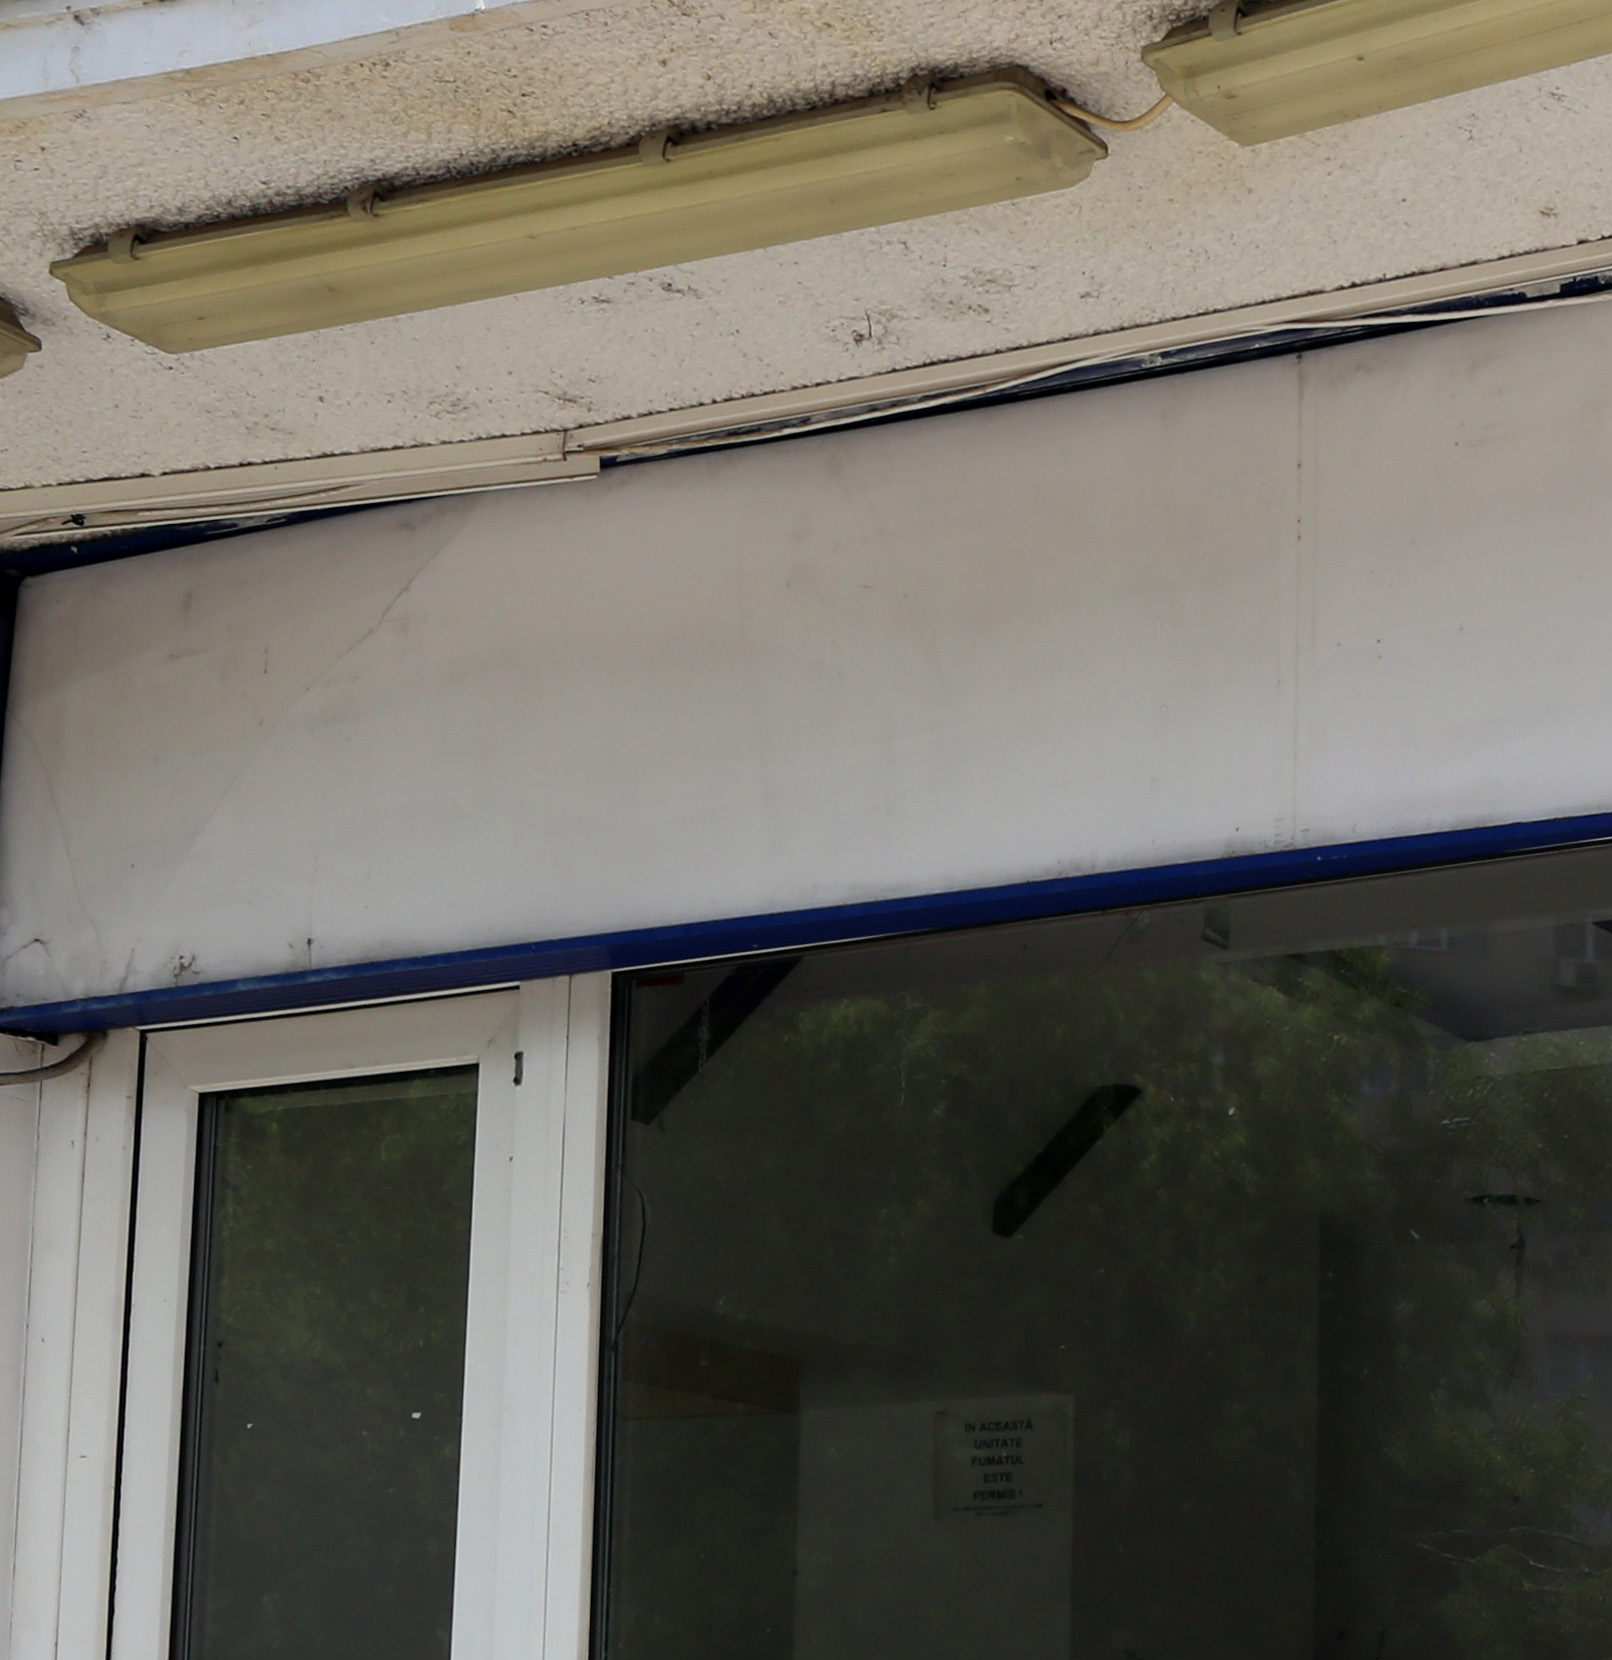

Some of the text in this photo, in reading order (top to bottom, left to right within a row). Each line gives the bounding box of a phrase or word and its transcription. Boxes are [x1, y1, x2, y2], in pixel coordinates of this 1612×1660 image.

[974, 1437, 1023, 1450] UNITATE
[971, 1455, 1025, 1467] FUMATUL
[983, 1472, 1013, 1484] ESTE
